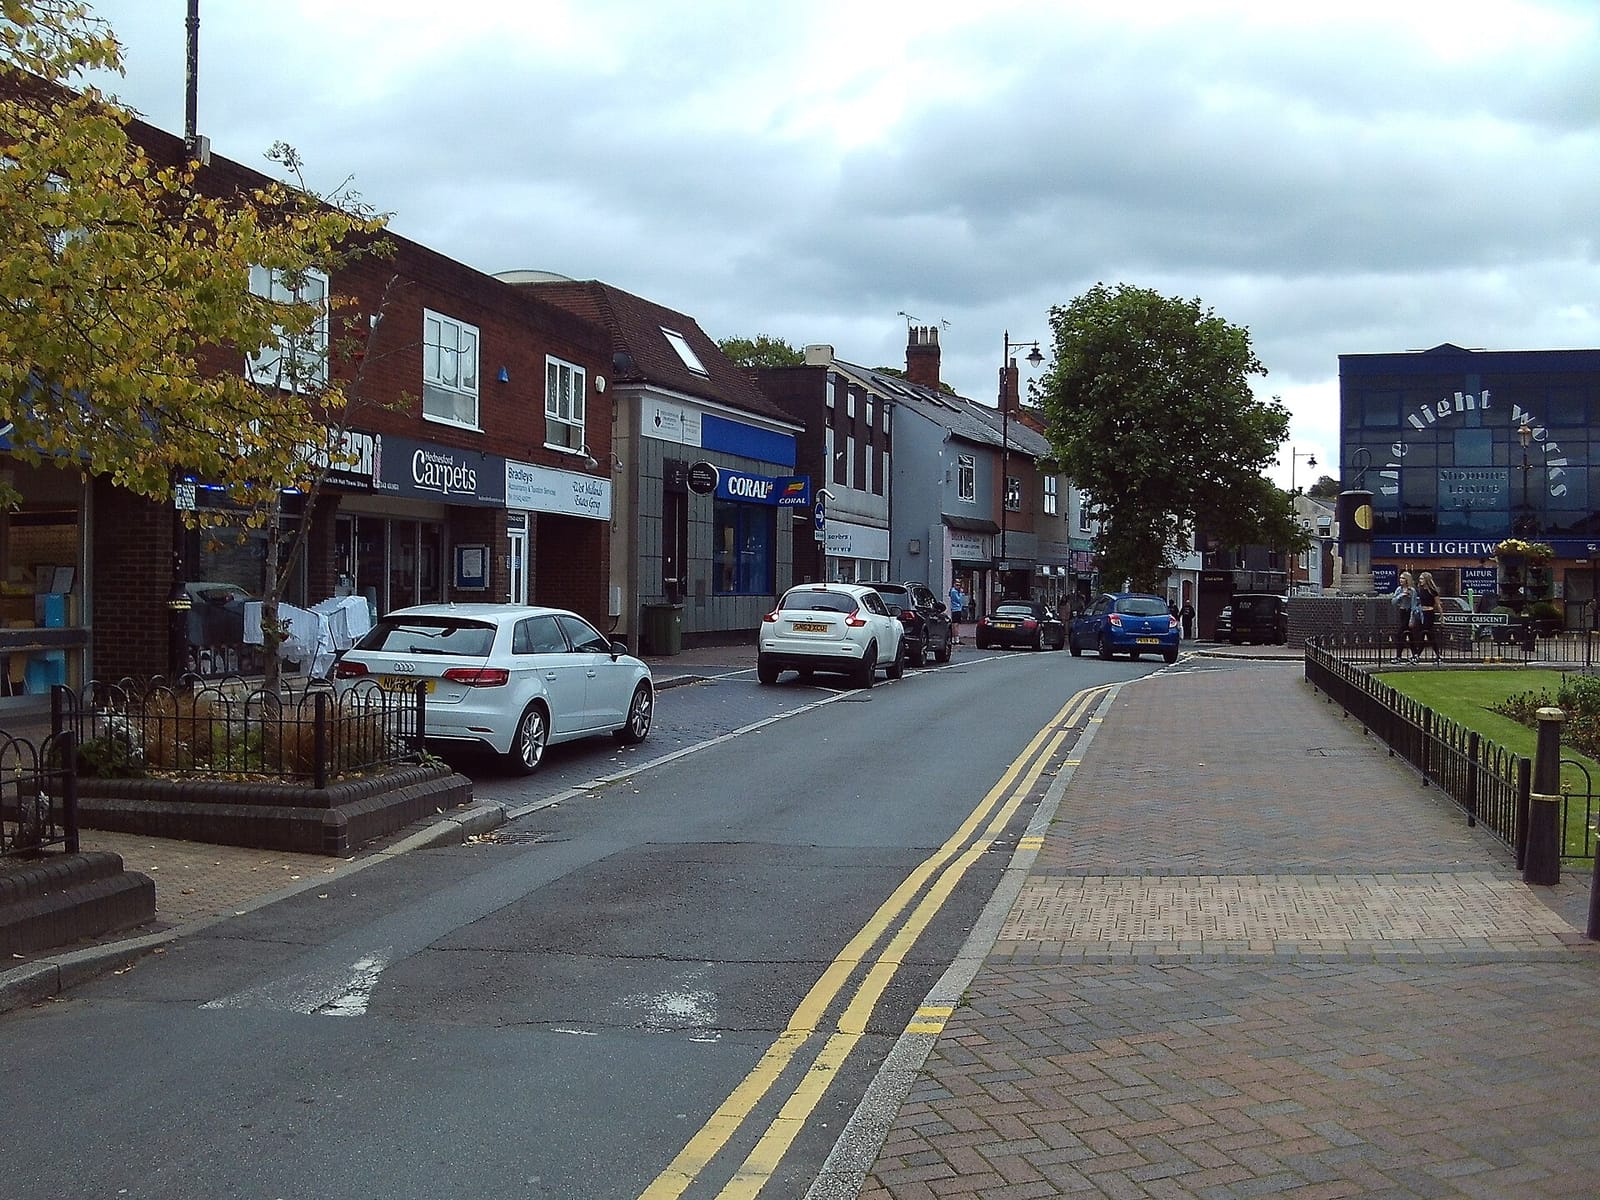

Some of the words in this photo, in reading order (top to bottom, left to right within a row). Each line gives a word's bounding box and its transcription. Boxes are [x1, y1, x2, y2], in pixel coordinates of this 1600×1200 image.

[1407, 389, 1492, 432] light
[1511, 403, 1568, 498] works
[425, 451, 454, 466] Hednesford
[412, 448, 477, 495] Carpets
[508, 466, 533, 484] Bradleys
[727, 476, 767, 499] CORAL
[1448, 484, 1501, 494] Leisure
[1391, 542, 1425, 554] THE
